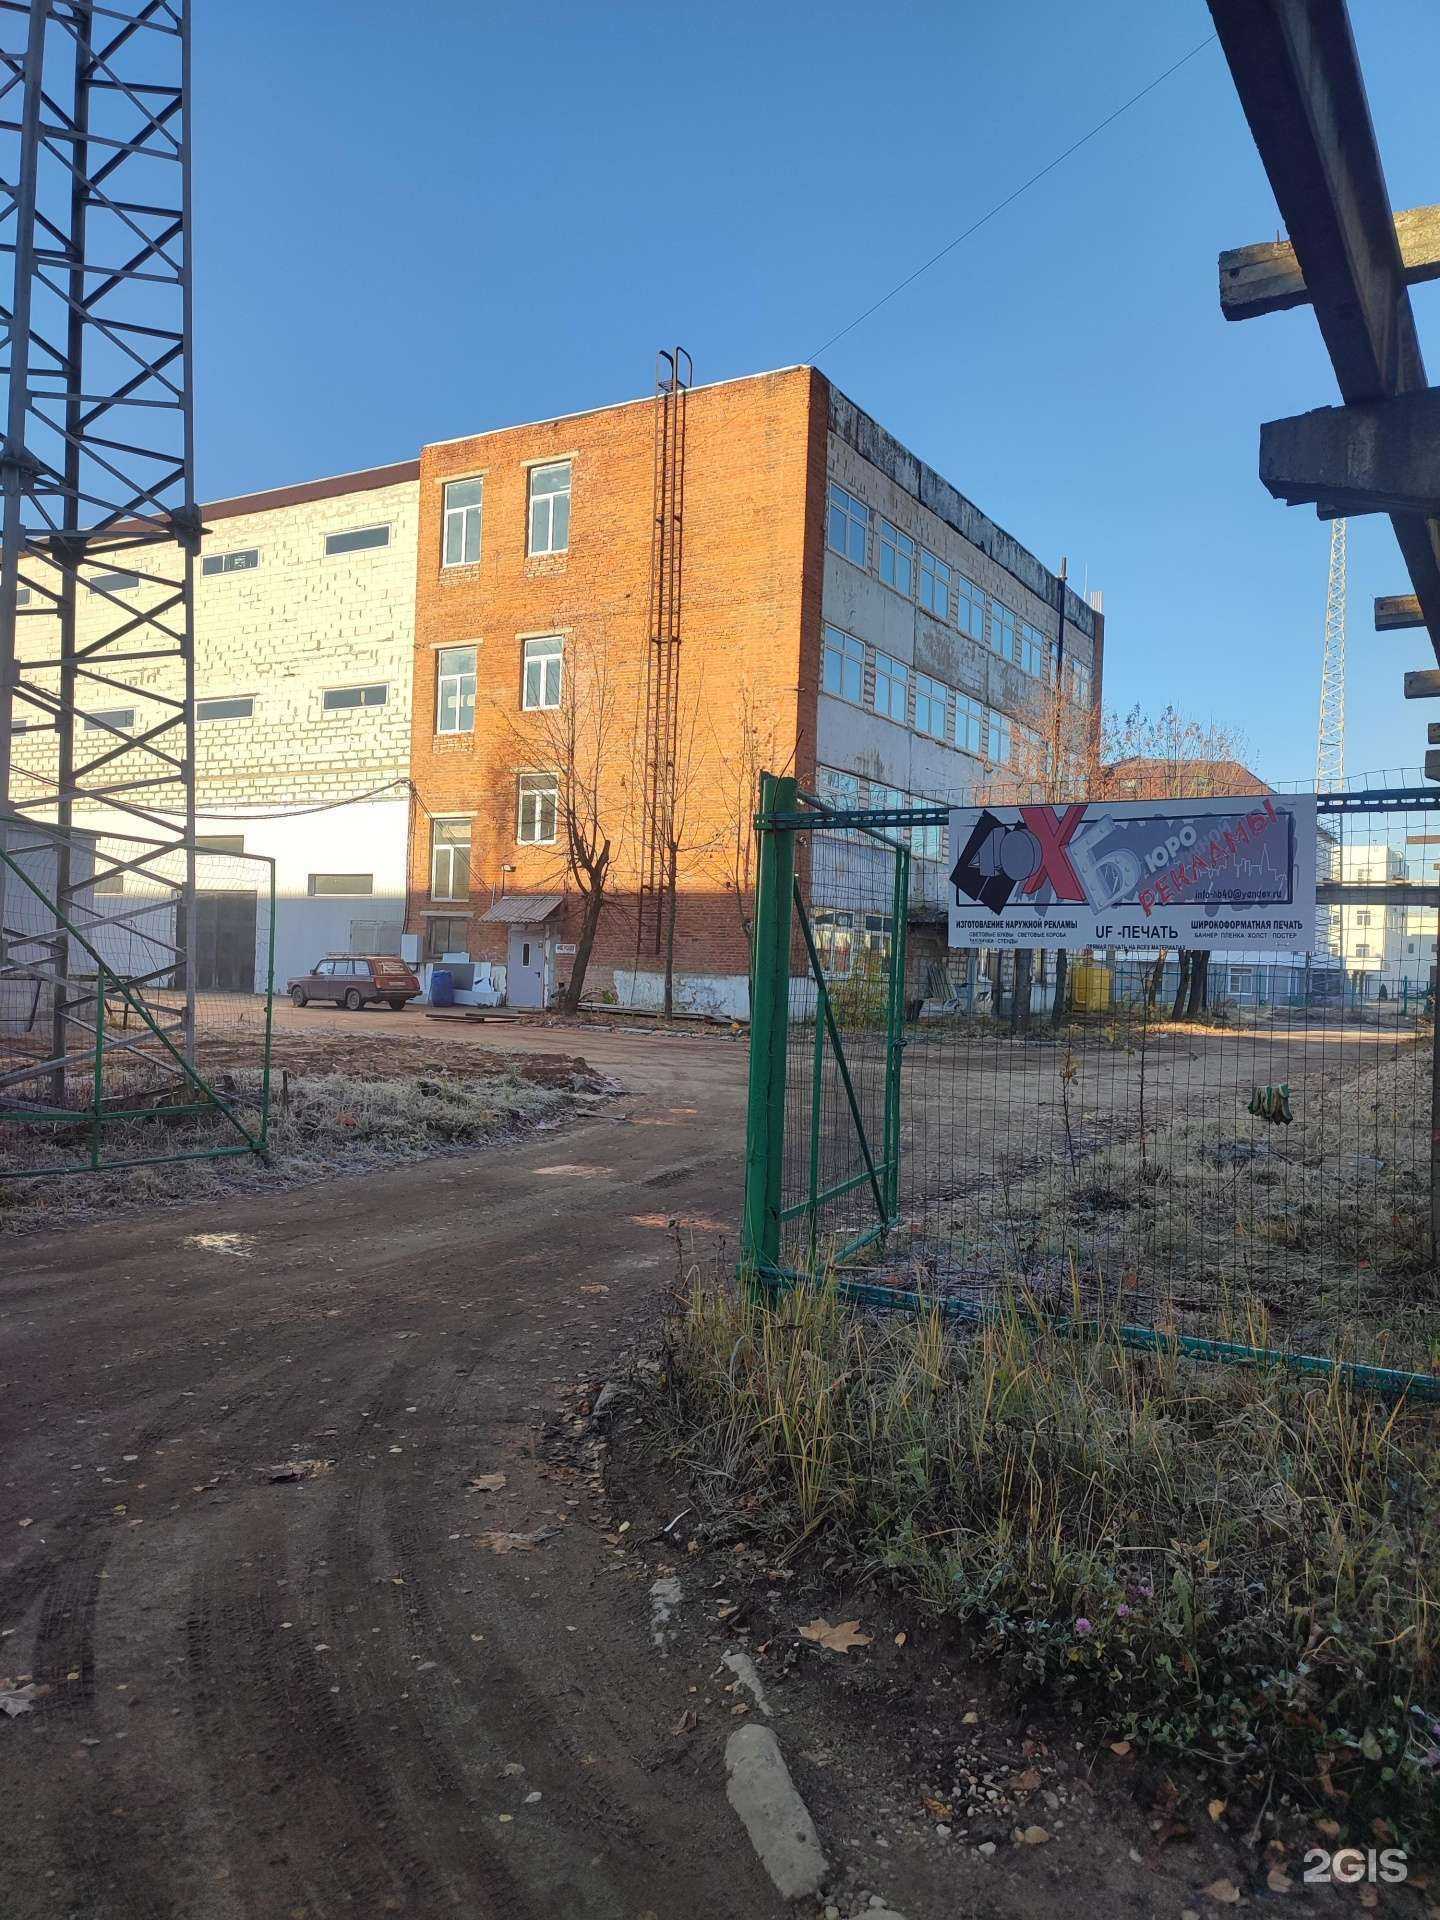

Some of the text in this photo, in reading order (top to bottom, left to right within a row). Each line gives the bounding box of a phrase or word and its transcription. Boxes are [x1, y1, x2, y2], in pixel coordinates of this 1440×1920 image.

[1138, 799, 1277, 917] РЕКЛАМЫ
[956, 918, 1078, 929] ИЗГОТОВЛЕНИЕ НАРУЖНОЙ РЕКЛАМЫ
[1191, 920, 1303, 929] ШИРОКОФОРМАТНАЯ ПЕЧАТЬ
[1095, 925, 1113, 939] UF
